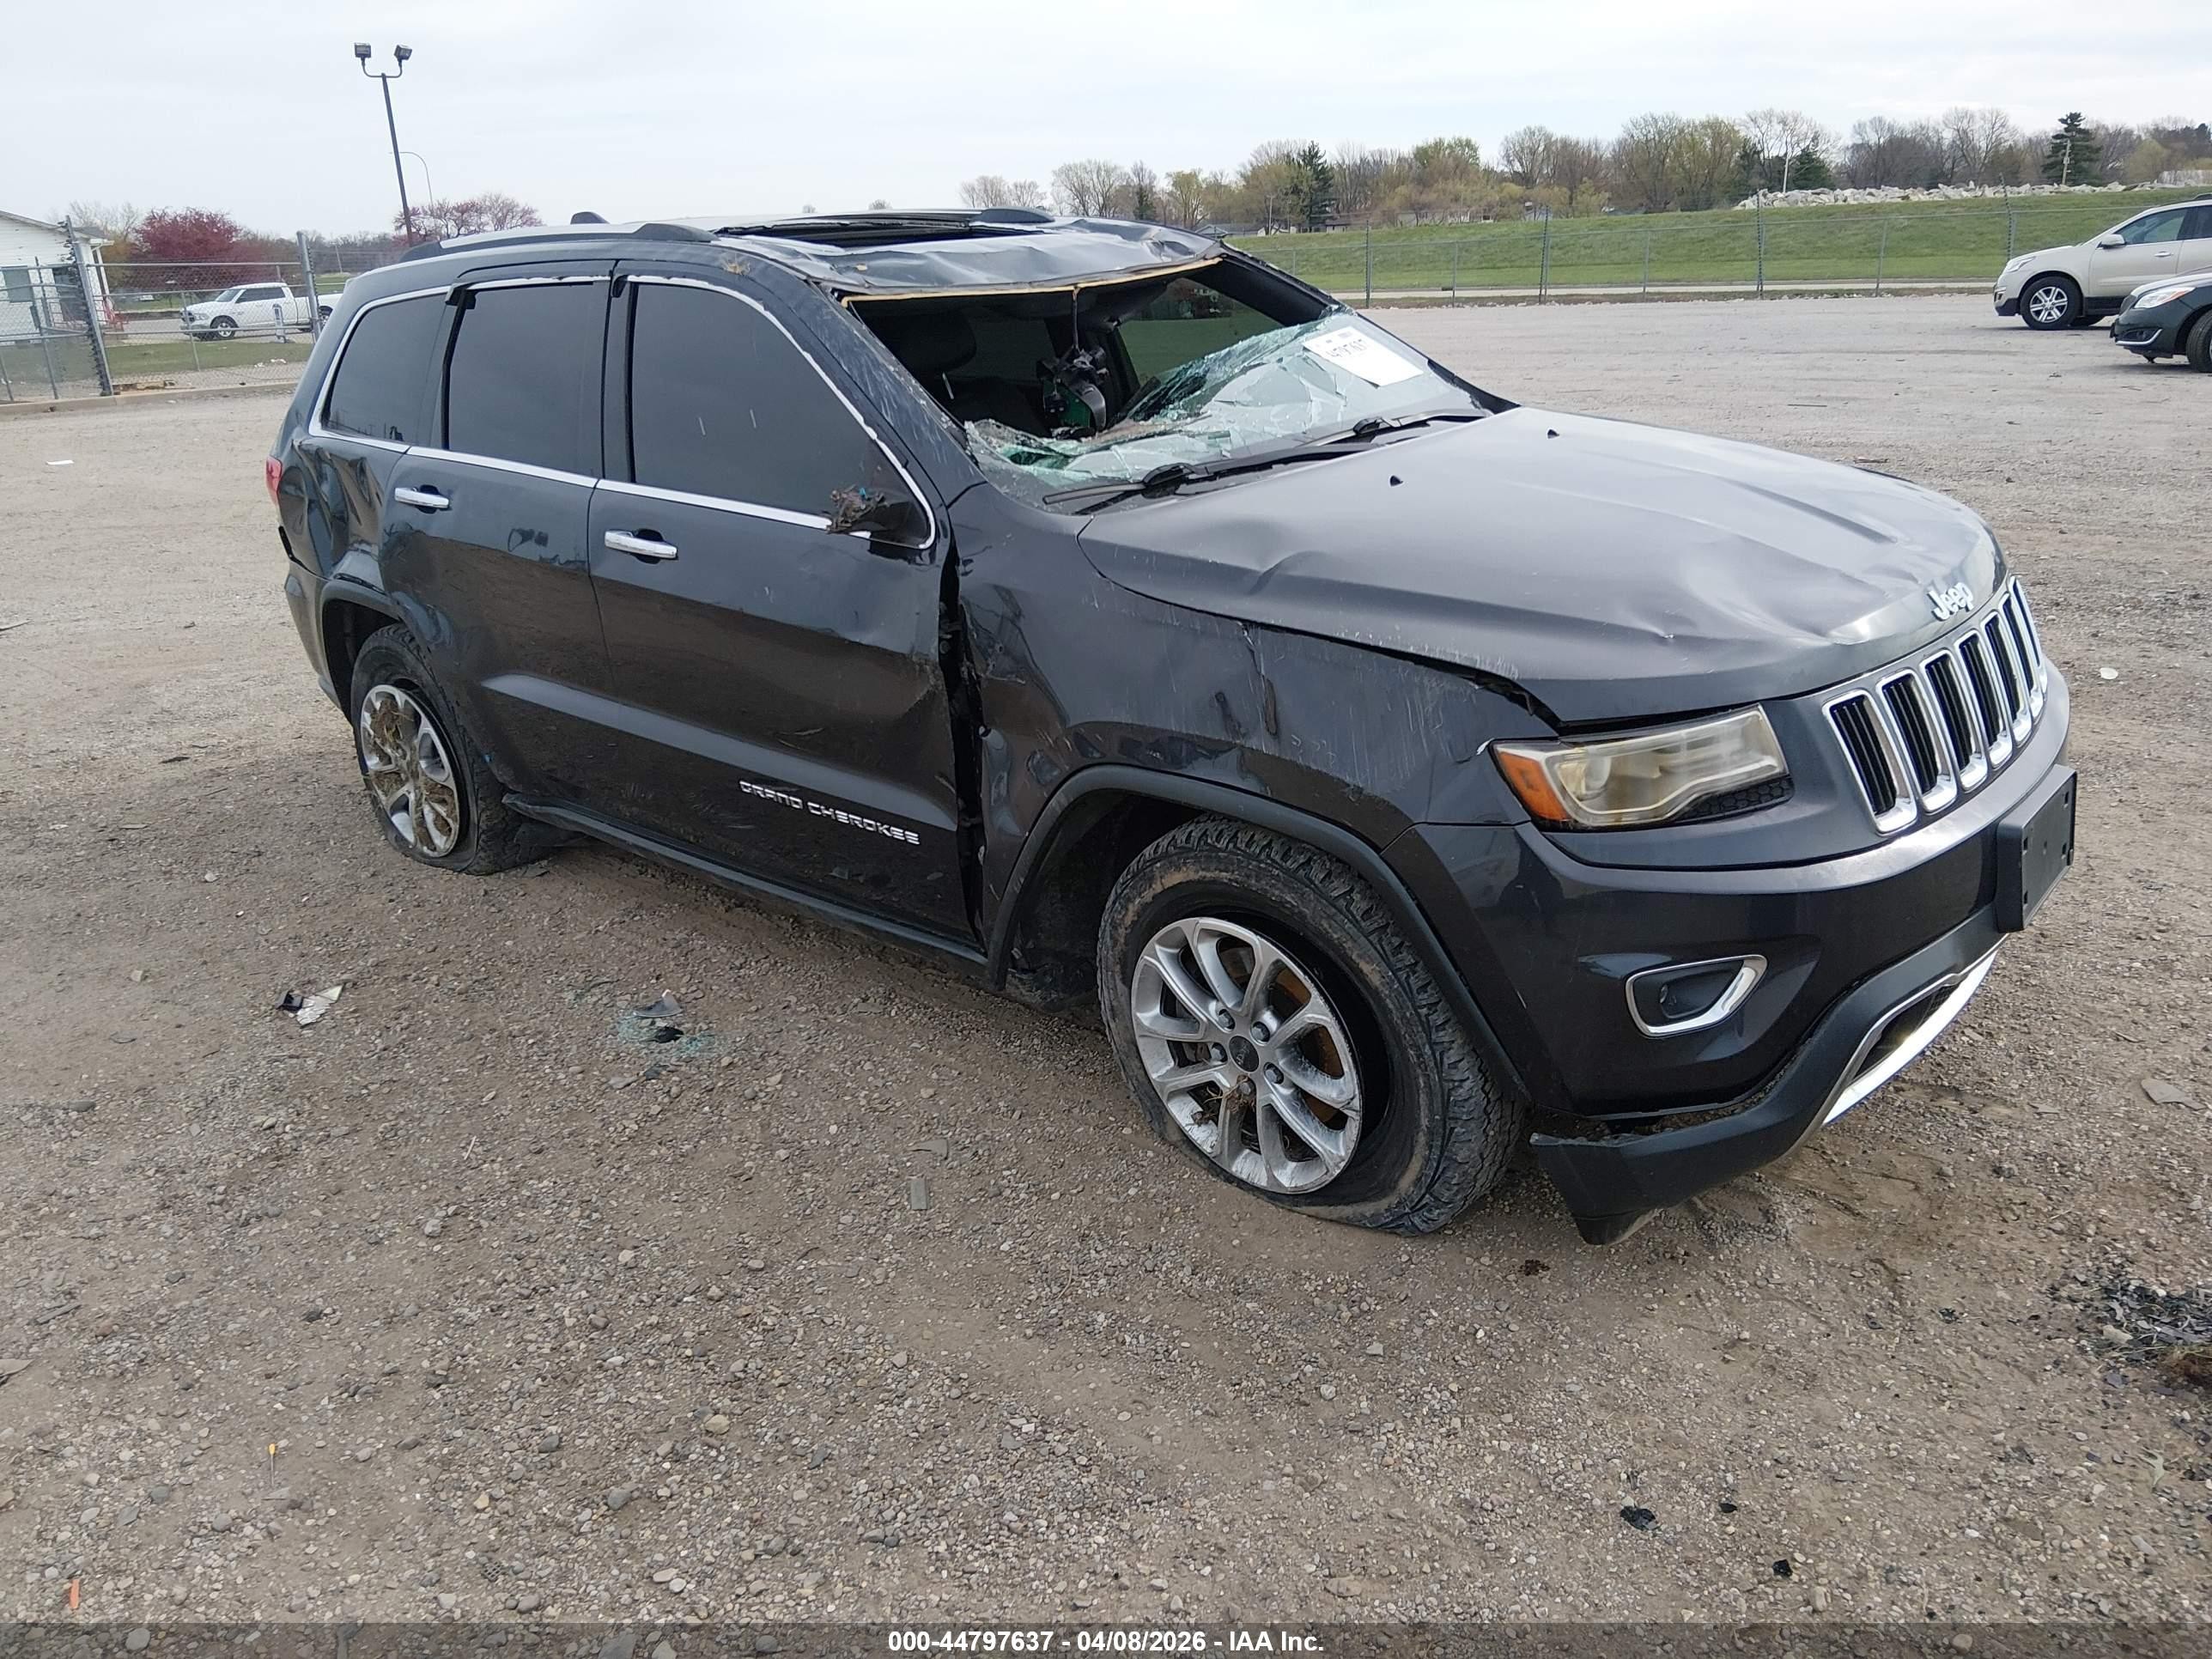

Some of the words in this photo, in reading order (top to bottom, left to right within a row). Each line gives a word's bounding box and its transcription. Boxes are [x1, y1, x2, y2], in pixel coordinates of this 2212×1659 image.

[1927, 582, 1974, 620] Jeep
[739, 781, 804, 809] GRAND
[807, 801, 921, 846] CHEROKEE
